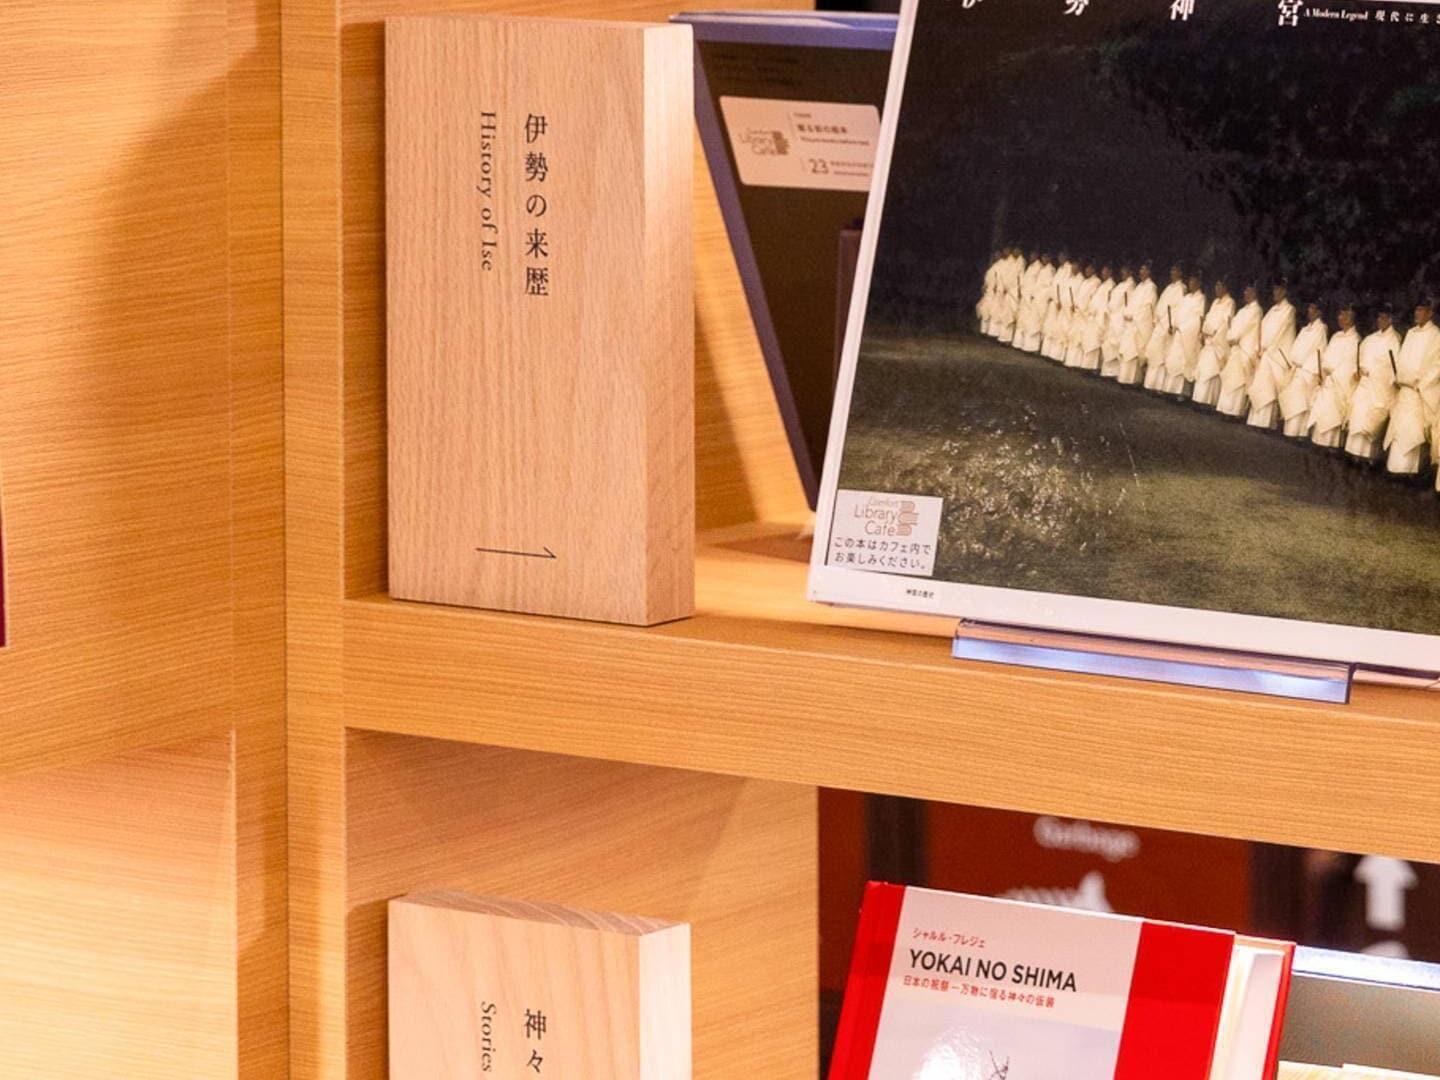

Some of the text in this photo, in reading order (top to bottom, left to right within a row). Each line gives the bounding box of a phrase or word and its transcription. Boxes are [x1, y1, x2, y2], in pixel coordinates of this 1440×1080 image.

[808, 158, 829, 175] 23
[476, 111, 499, 271] History of Ise
[524, 113, 549, 297] 伊勢の来歴
[854, 504, 898, 525] Library
[834, 536, 932, 555] この本はカフェ内で
[835, 552, 925, 570] お楽しみください。
[912, 928, 986, 949] シャルル・フレジェ
[909, 948, 1077, 993] YOKAI NO SHIMA
[480, 1000, 497, 1073] Stories
[523, 1008, 548, 1074] 神々
